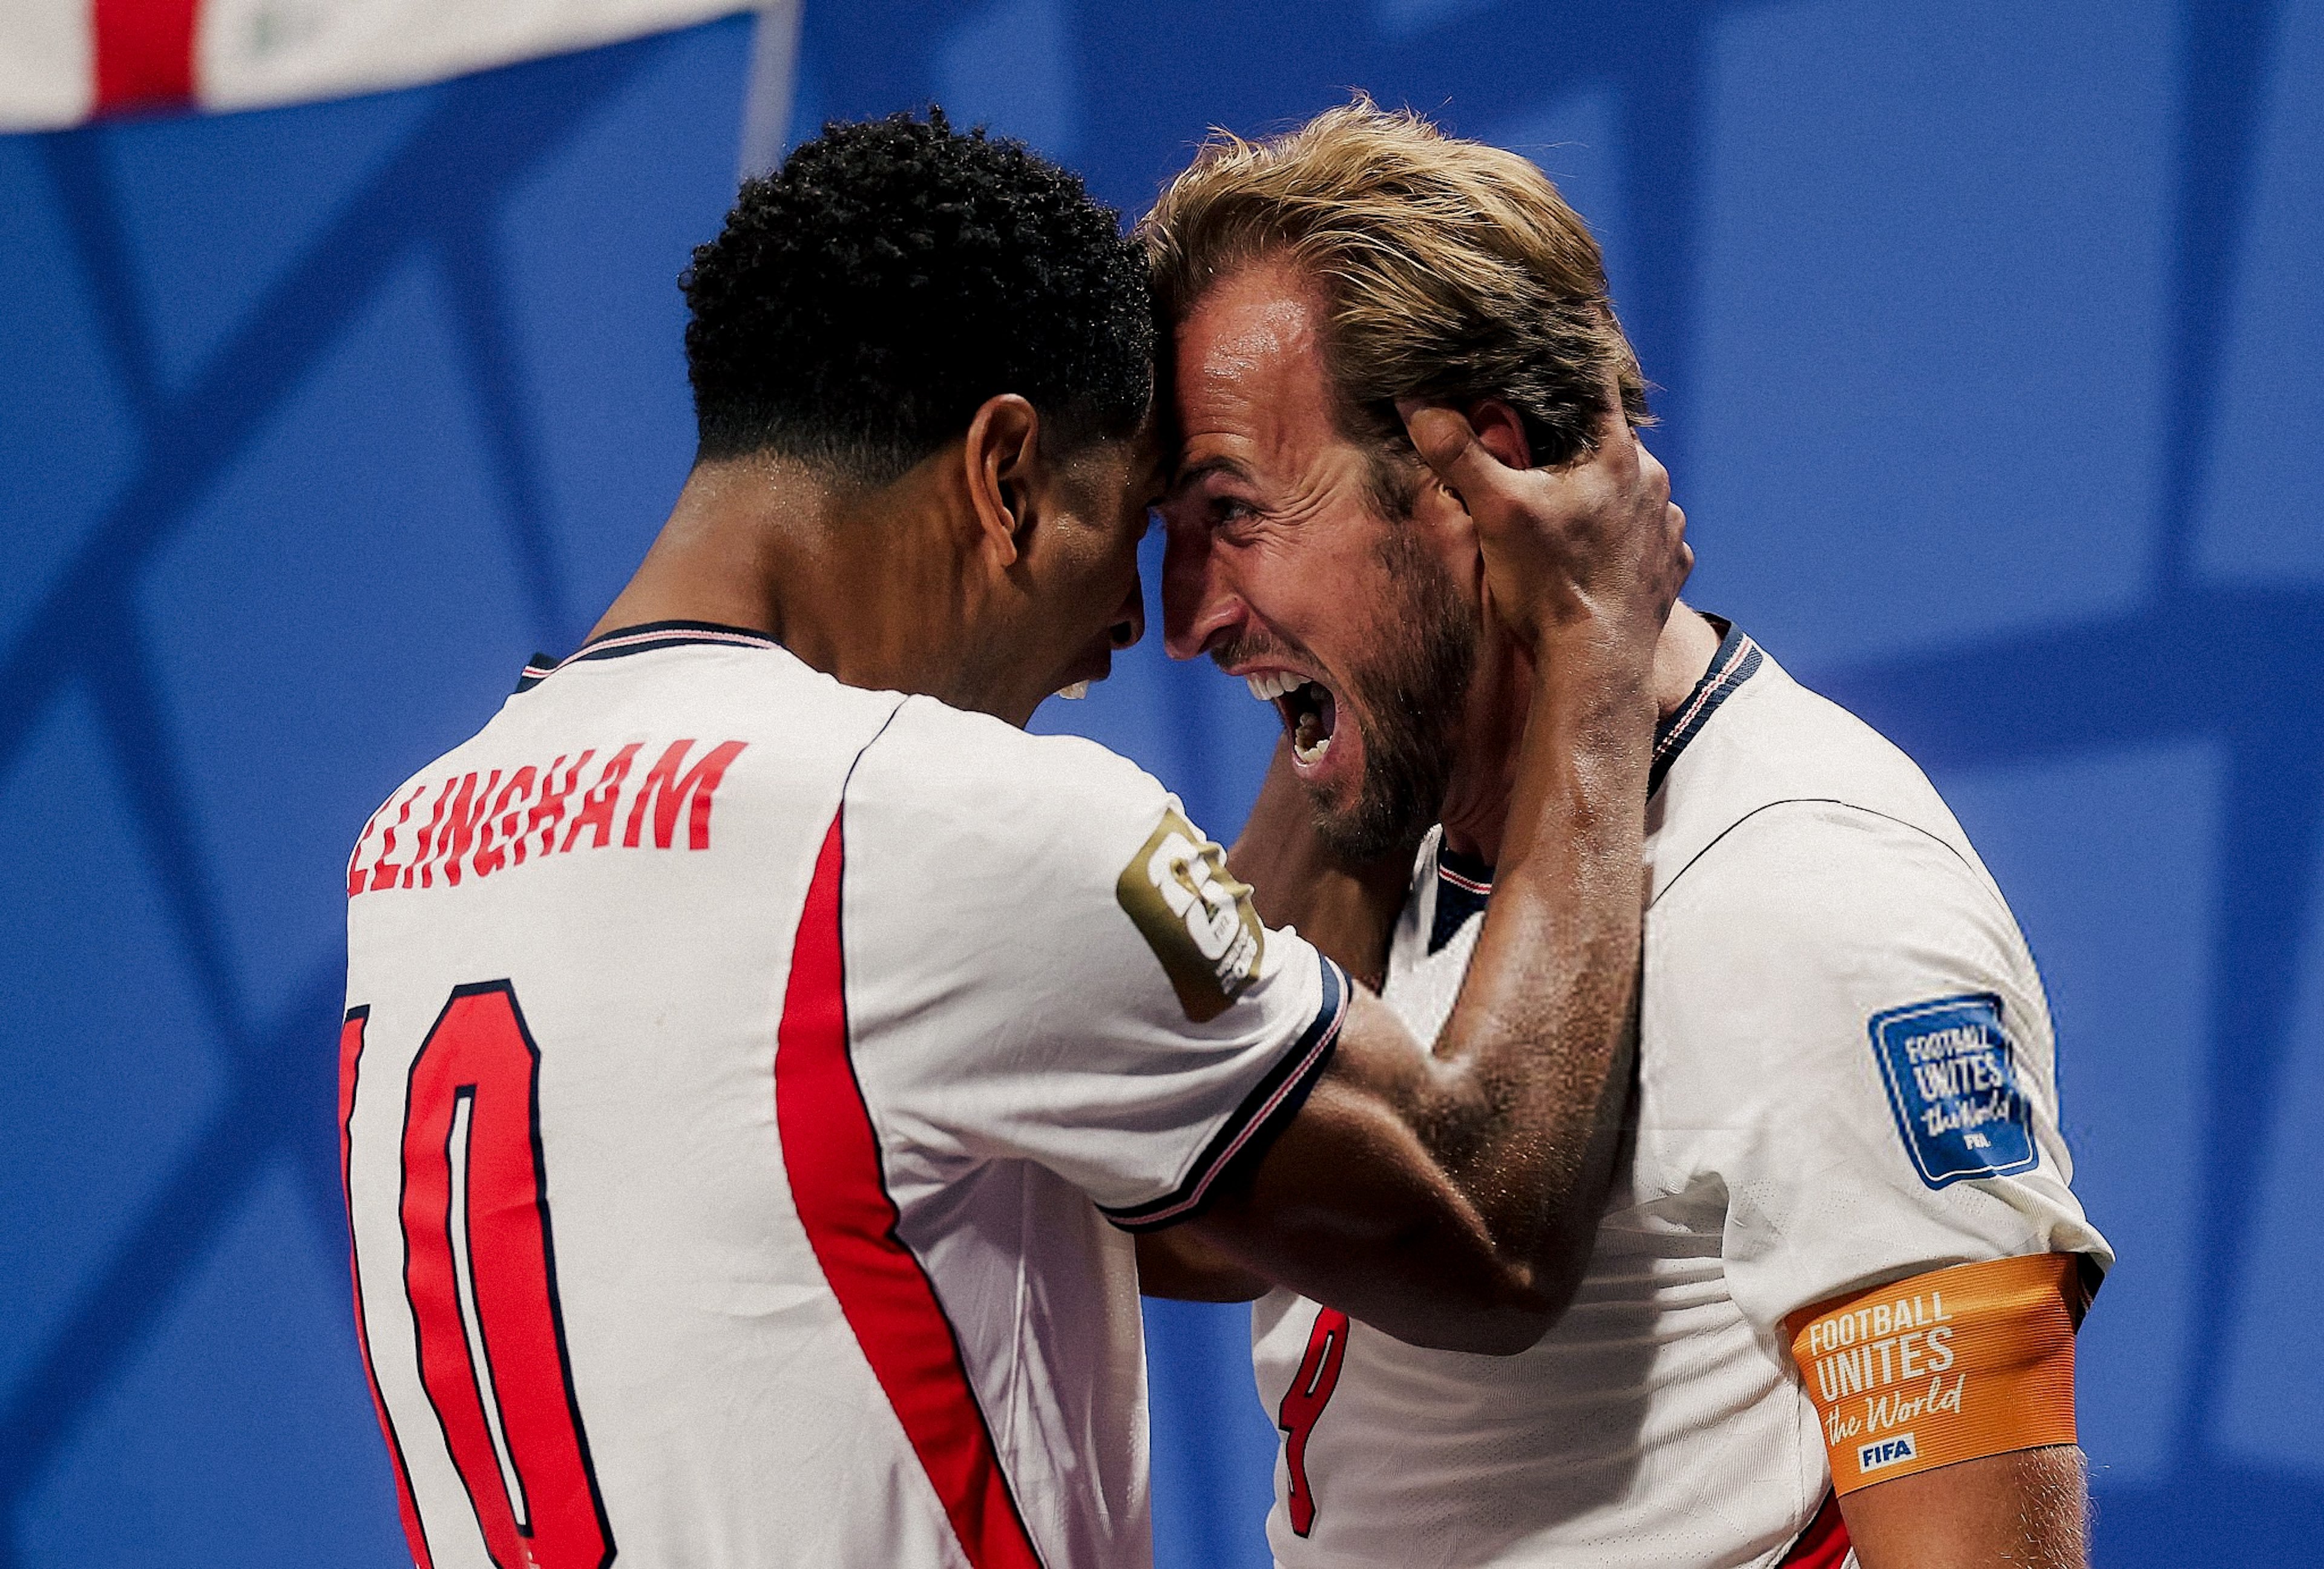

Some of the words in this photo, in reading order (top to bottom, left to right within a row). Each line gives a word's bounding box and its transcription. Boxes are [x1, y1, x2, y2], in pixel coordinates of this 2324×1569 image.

[1810, 1291, 1953, 1357] FOOTBALL
[1816, 1326, 1955, 1403] UNITES
[1279, 1306, 1350, 1539] 9
[1825, 1404, 1862, 1447] the
[1865, 1374, 1966, 1432] World
[1862, 1440, 1911, 1467] FIFA
